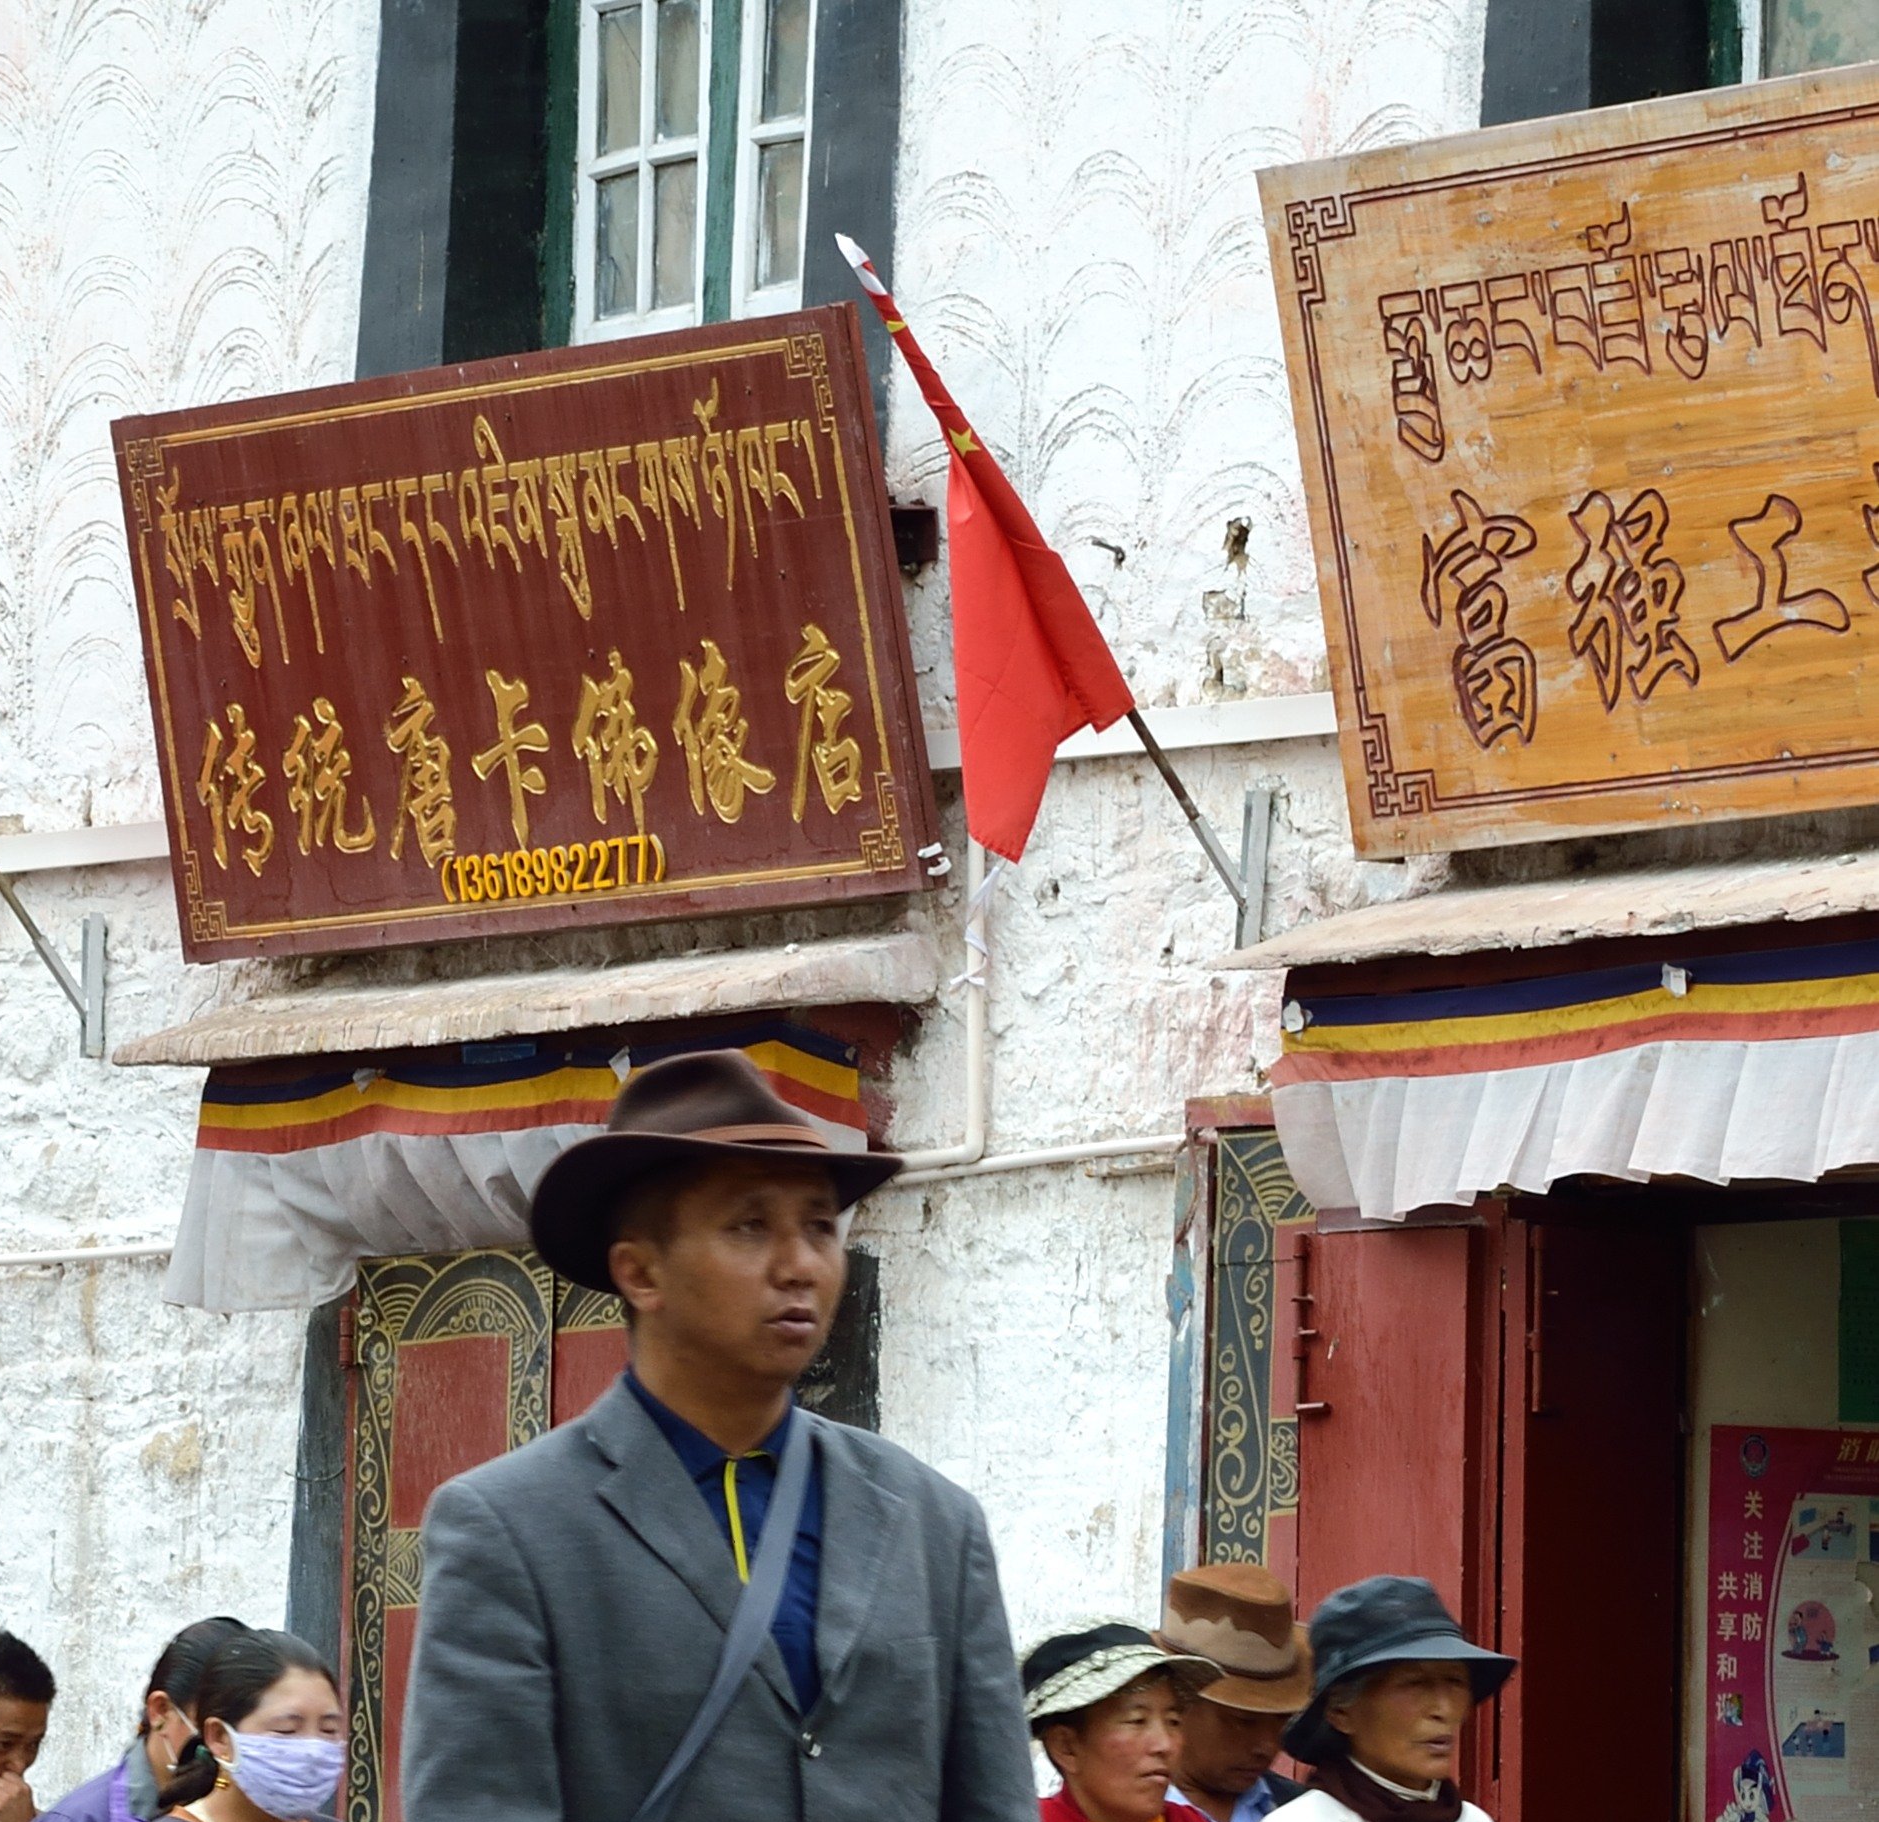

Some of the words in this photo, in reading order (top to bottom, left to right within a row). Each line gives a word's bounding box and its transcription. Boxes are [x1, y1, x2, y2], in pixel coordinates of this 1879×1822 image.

[1421, 463, 1879, 749] 富强工
[197, 624, 862, 877] 传统唐卡佛像店
[442, 834, 666, 903] (13618982277)
[1743, 1491, 1763, 1641] 关注消防
